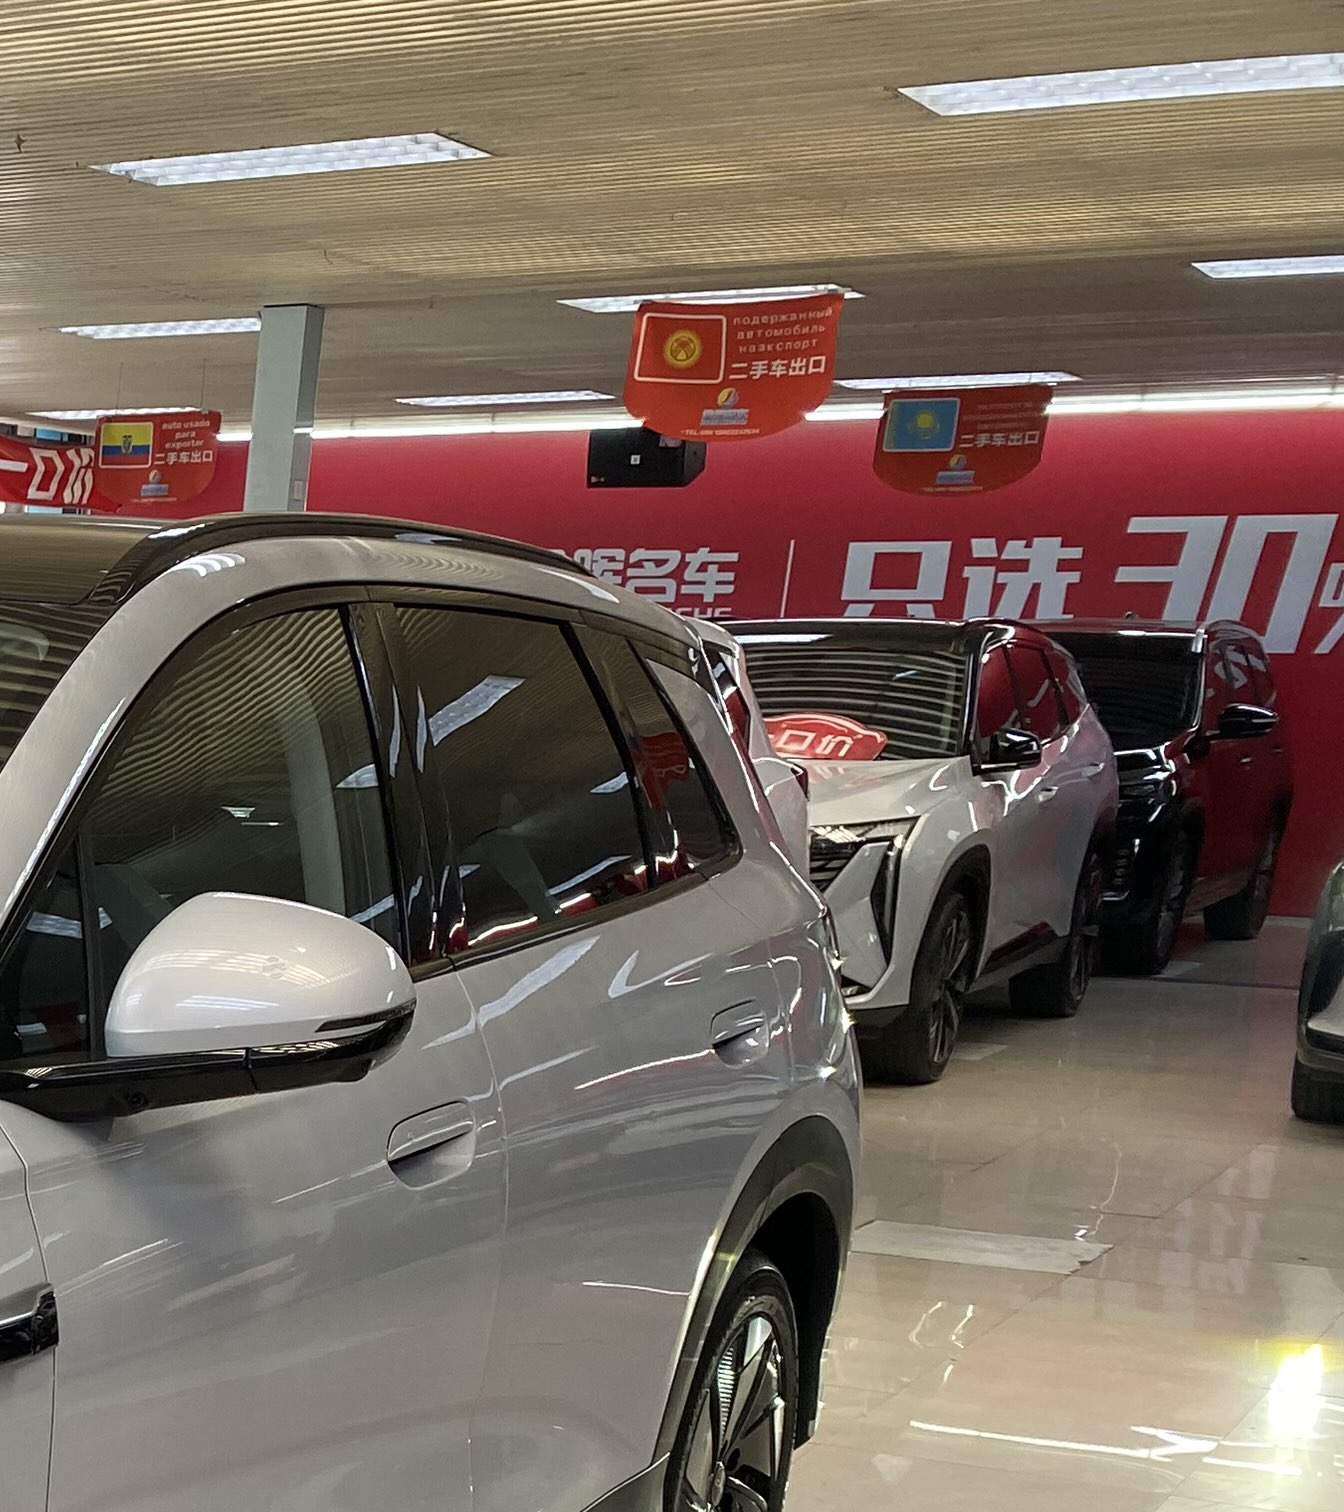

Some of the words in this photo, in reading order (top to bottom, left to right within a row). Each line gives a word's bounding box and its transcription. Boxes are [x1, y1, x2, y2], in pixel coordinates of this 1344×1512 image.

[733, 306, 833, 327] подержанный
[736, 323, 826, 340] автомобиль
[728, 355, 827, 380] 二手车出口
[165, 440, 204, 449] exportar
[959, 430, 1041, 448] 二手车出口
[154, 451, 213, 465] 二手车出口
[552, 547, 740, 603] 晖名车
[767, 729, 854, 758] 口价
